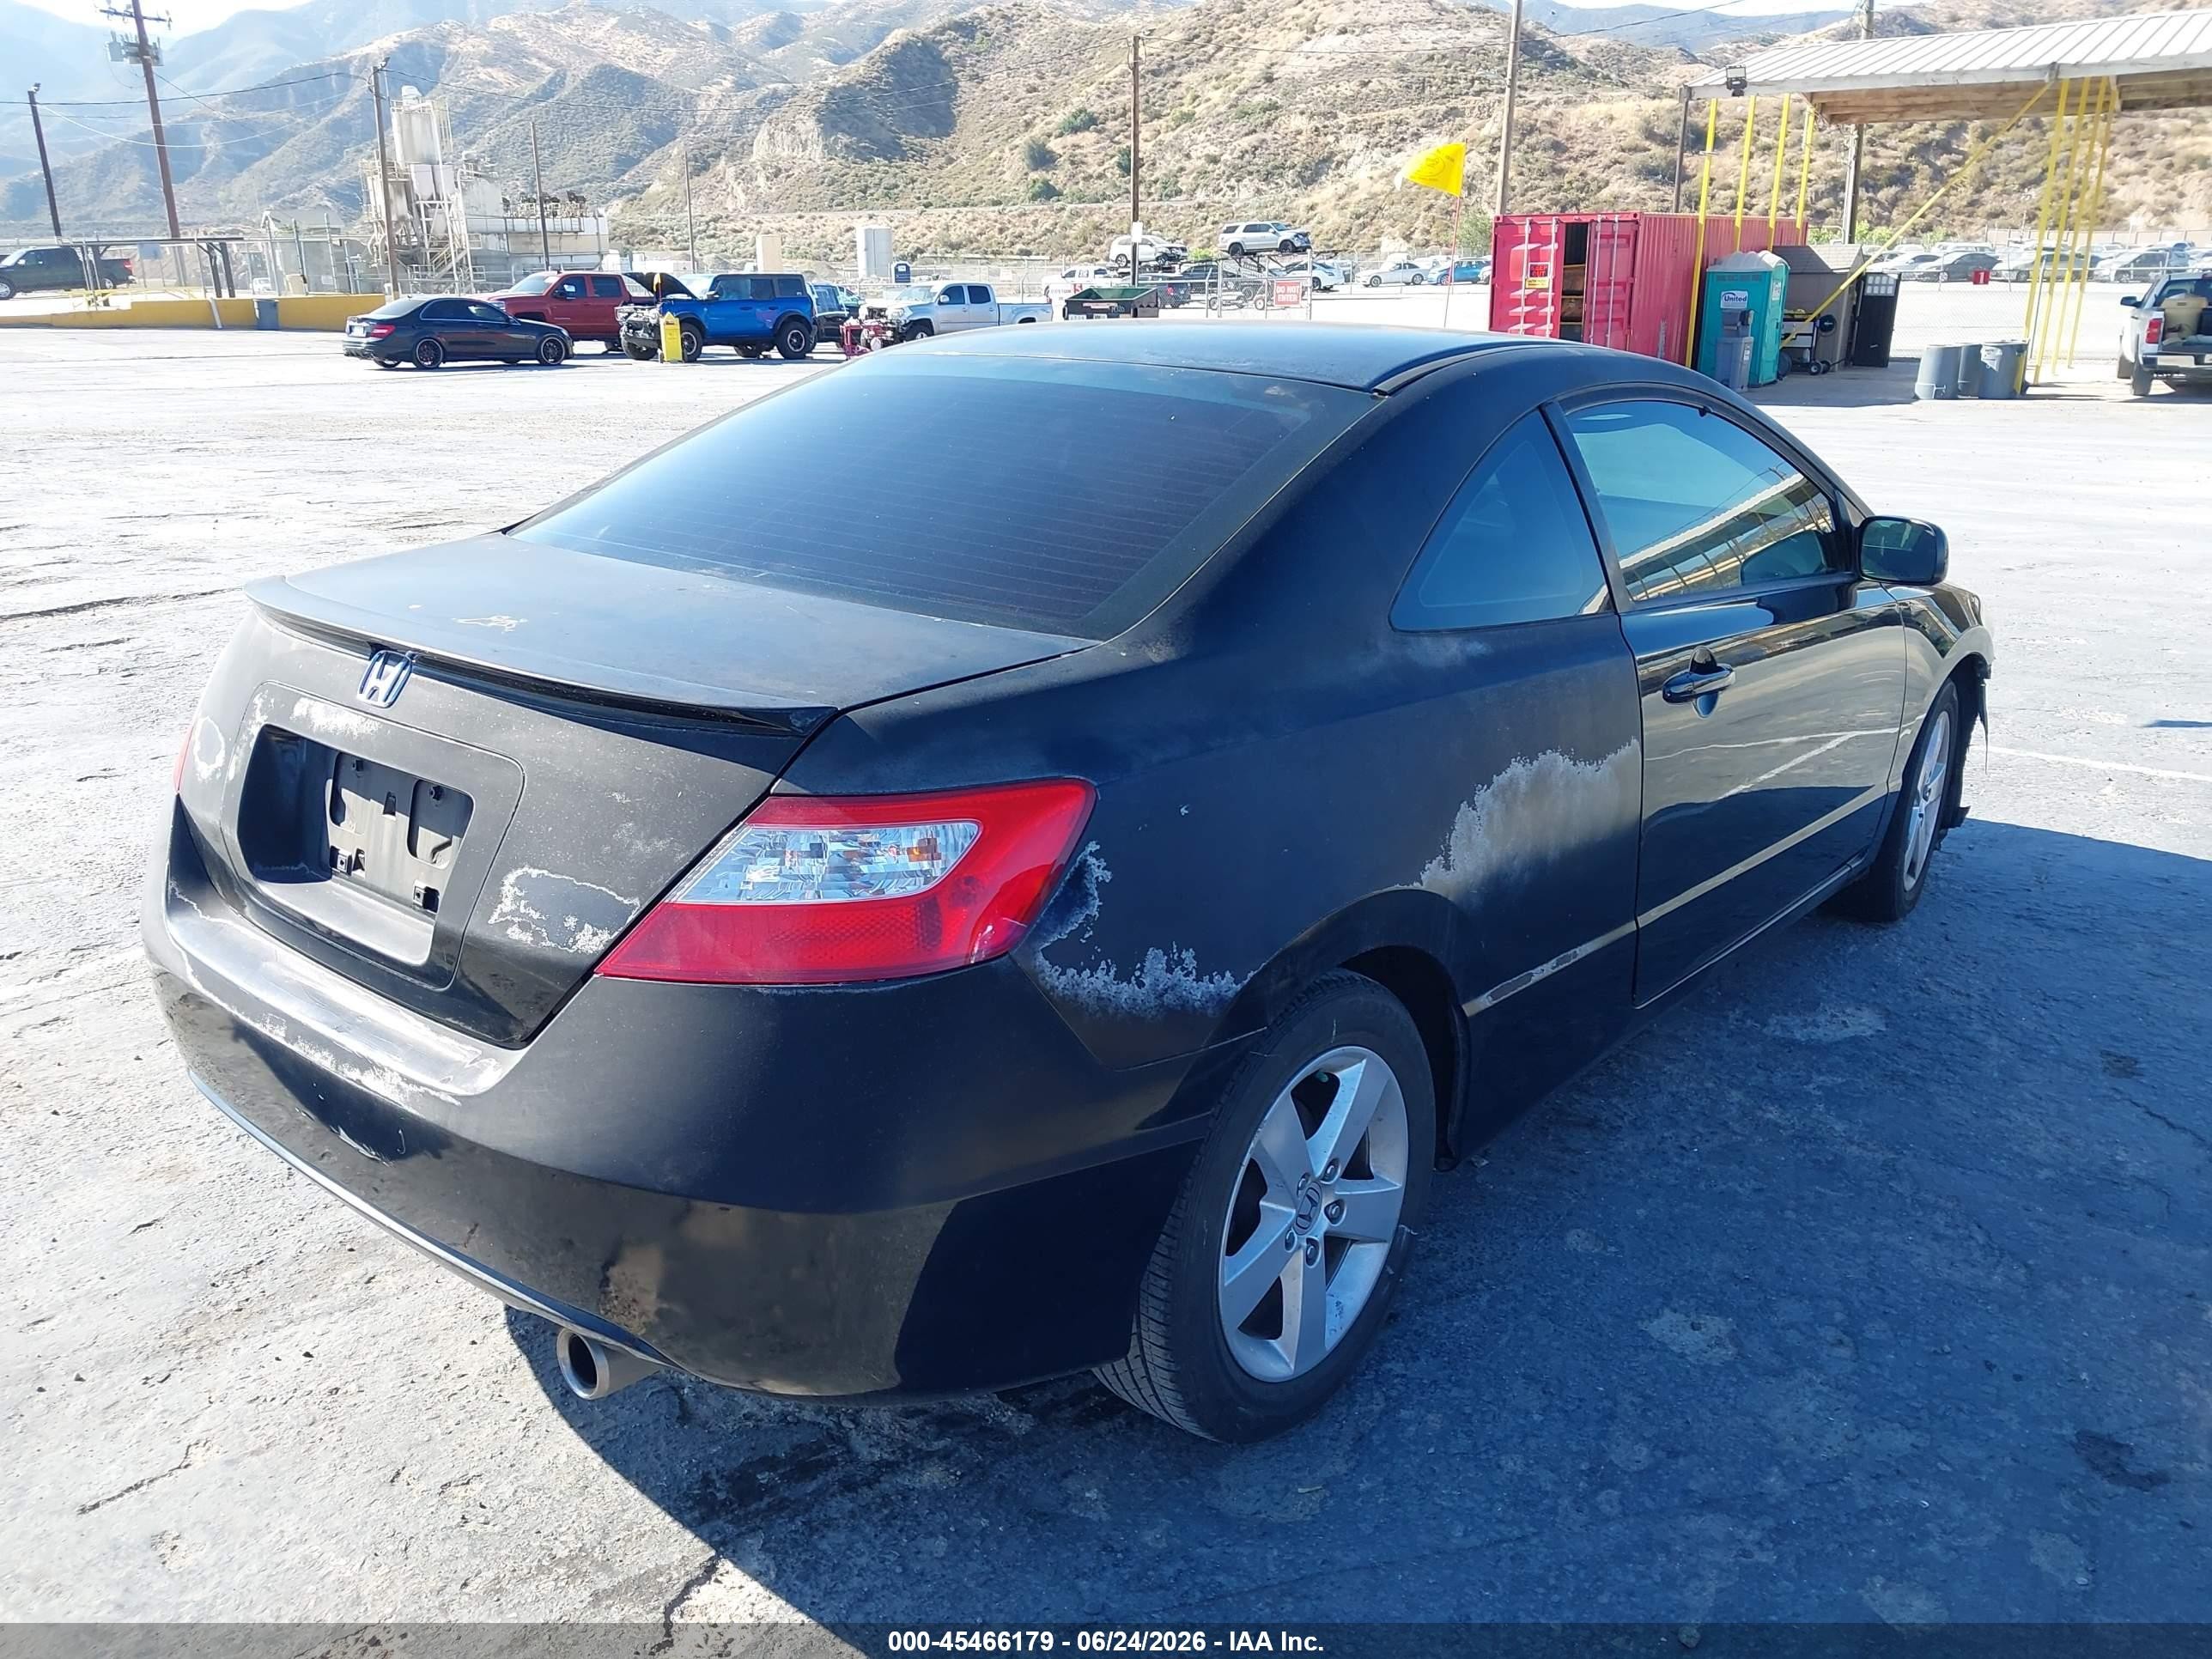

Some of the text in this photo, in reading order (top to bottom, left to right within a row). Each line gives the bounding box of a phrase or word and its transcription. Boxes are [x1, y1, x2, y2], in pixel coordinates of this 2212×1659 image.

[1978, 271, 1984, 284] 1
[1276, 285, 1300, 294] DO NOT
[1277, 294, 1298, 302] ENTER
